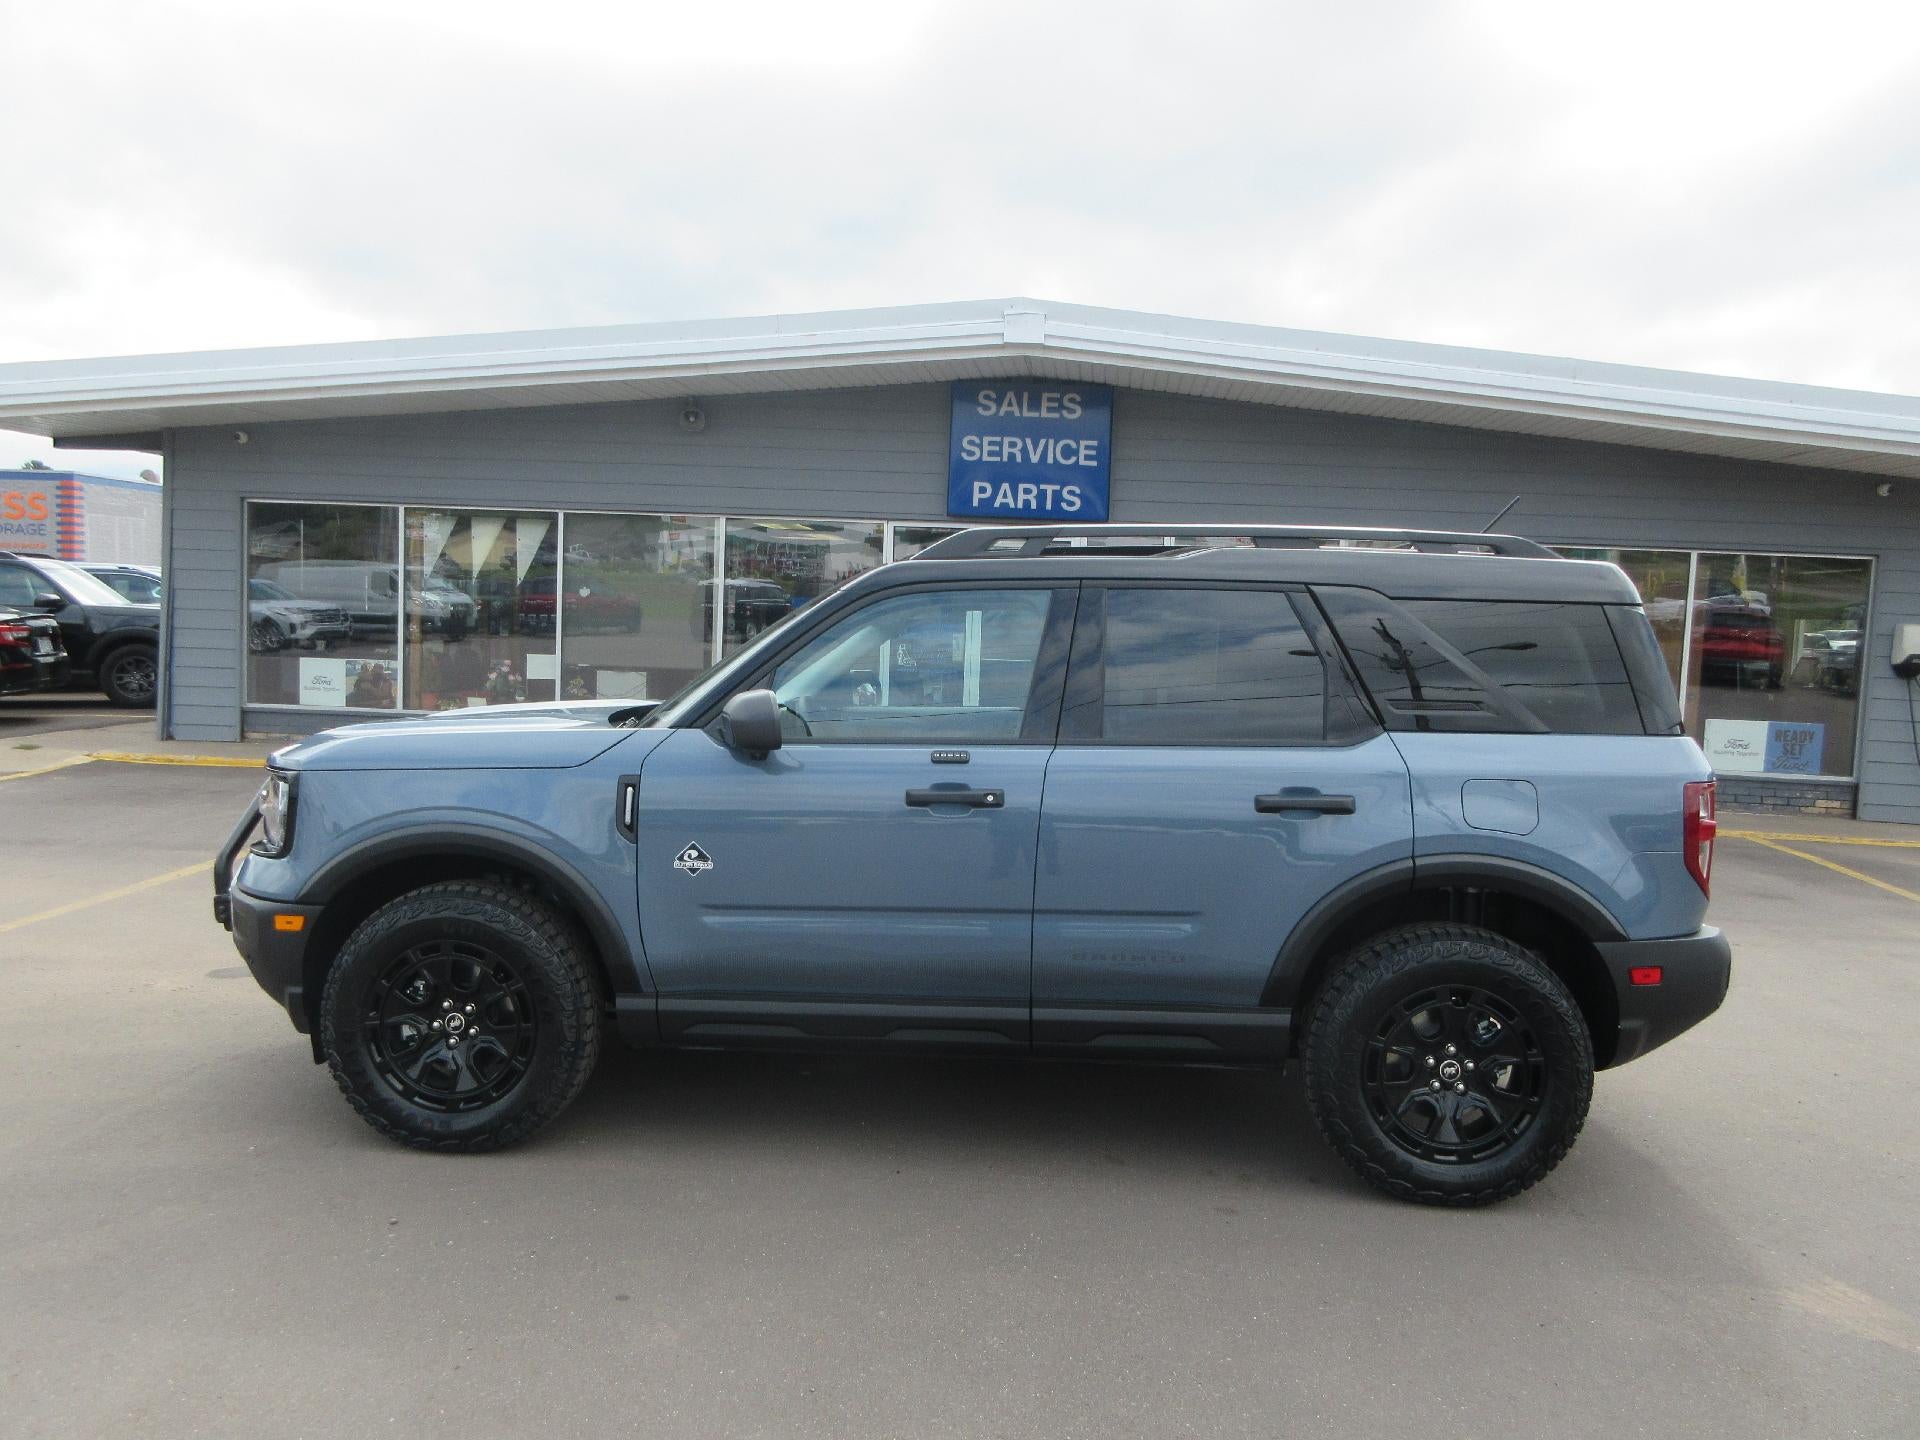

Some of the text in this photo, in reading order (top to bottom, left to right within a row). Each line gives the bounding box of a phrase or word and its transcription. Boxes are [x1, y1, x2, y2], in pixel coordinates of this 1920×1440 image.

[977, 389, 1083, 420] SALES
[960, 435, 1099, 467] SERVICE
[0, 491, 49, 521] SS
[972, 481, 1082, 512] PARTS
[1723, 738, 1752, 750] Ford
[1775, 729, 1816, 743] READY
[1781, 743, 1805, 757] SET
